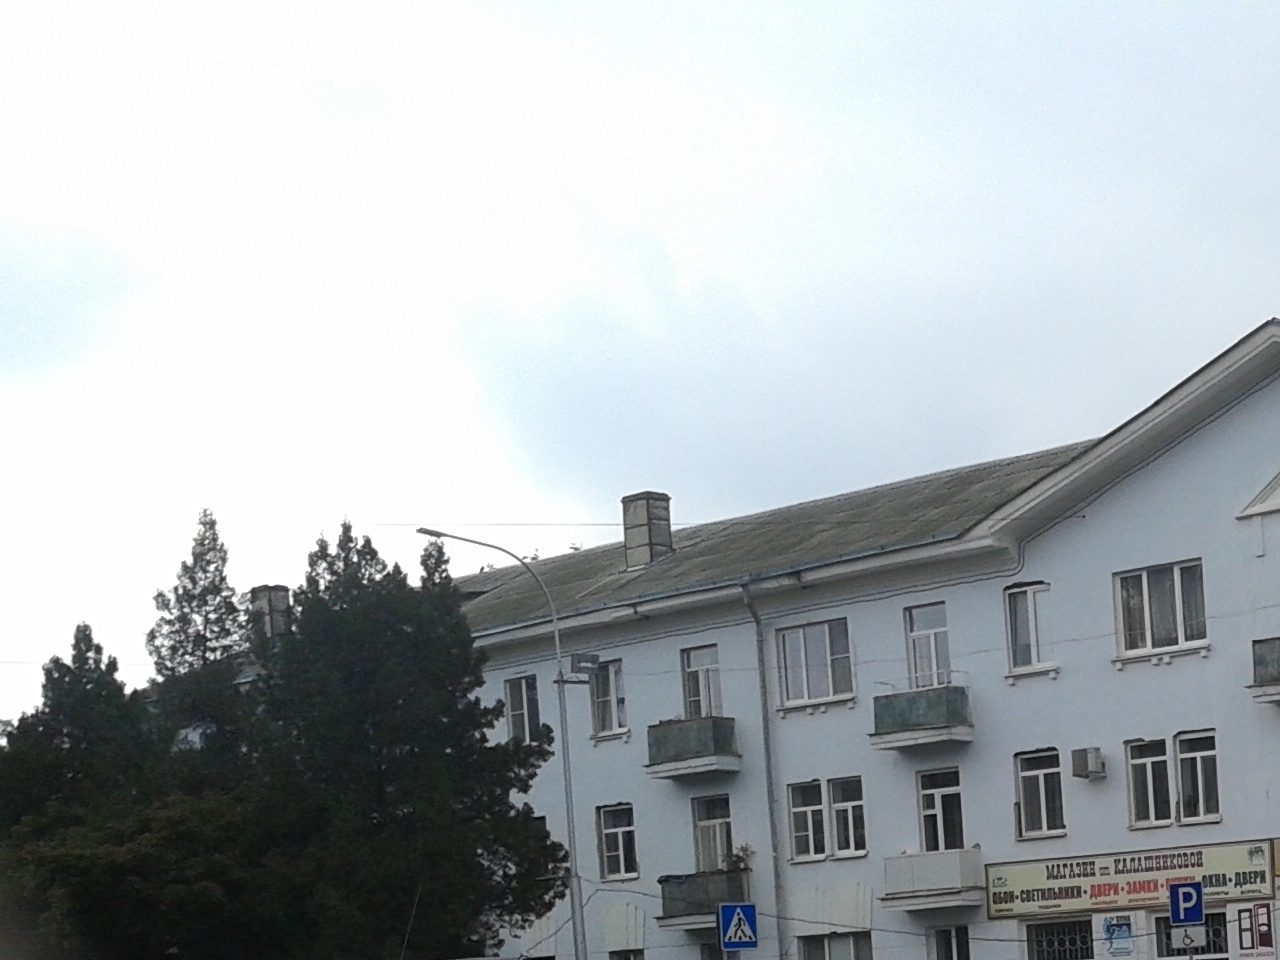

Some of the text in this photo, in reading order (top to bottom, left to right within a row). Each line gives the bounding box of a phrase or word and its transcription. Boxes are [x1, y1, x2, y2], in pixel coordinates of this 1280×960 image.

[1046, 861, 1096, 880] МАГАЗИН
[992, 890, 1015, 905] ОБОИ
[1020, 885, 1082, 903] СВЕТИЛЬНИКИ
[1089, 882, 1119, 900] ДВЕРИ
[1125, 879, 1159, 895] ЗАМКИ
[1201, 873, 1227, 889] ОКНА
[1234, 870, 1267, 889] ДВЕРИ
